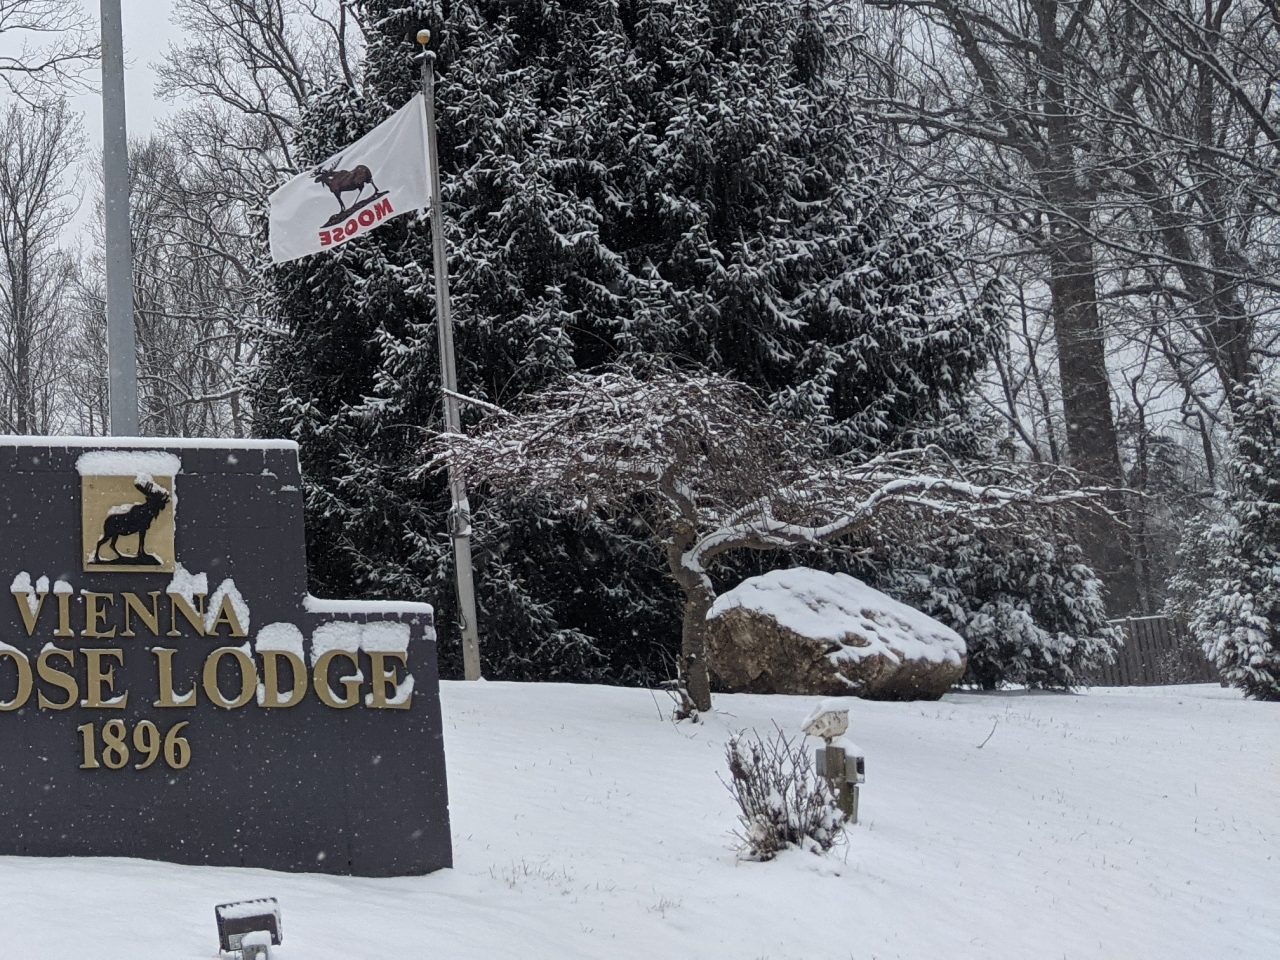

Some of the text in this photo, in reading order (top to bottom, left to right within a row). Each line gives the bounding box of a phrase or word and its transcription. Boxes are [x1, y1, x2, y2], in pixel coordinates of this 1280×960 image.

[12, 590, 250, 639] VIENNA
[151, 646, 413, 711] LODGE
[77, 719, 192, 770] 1896
